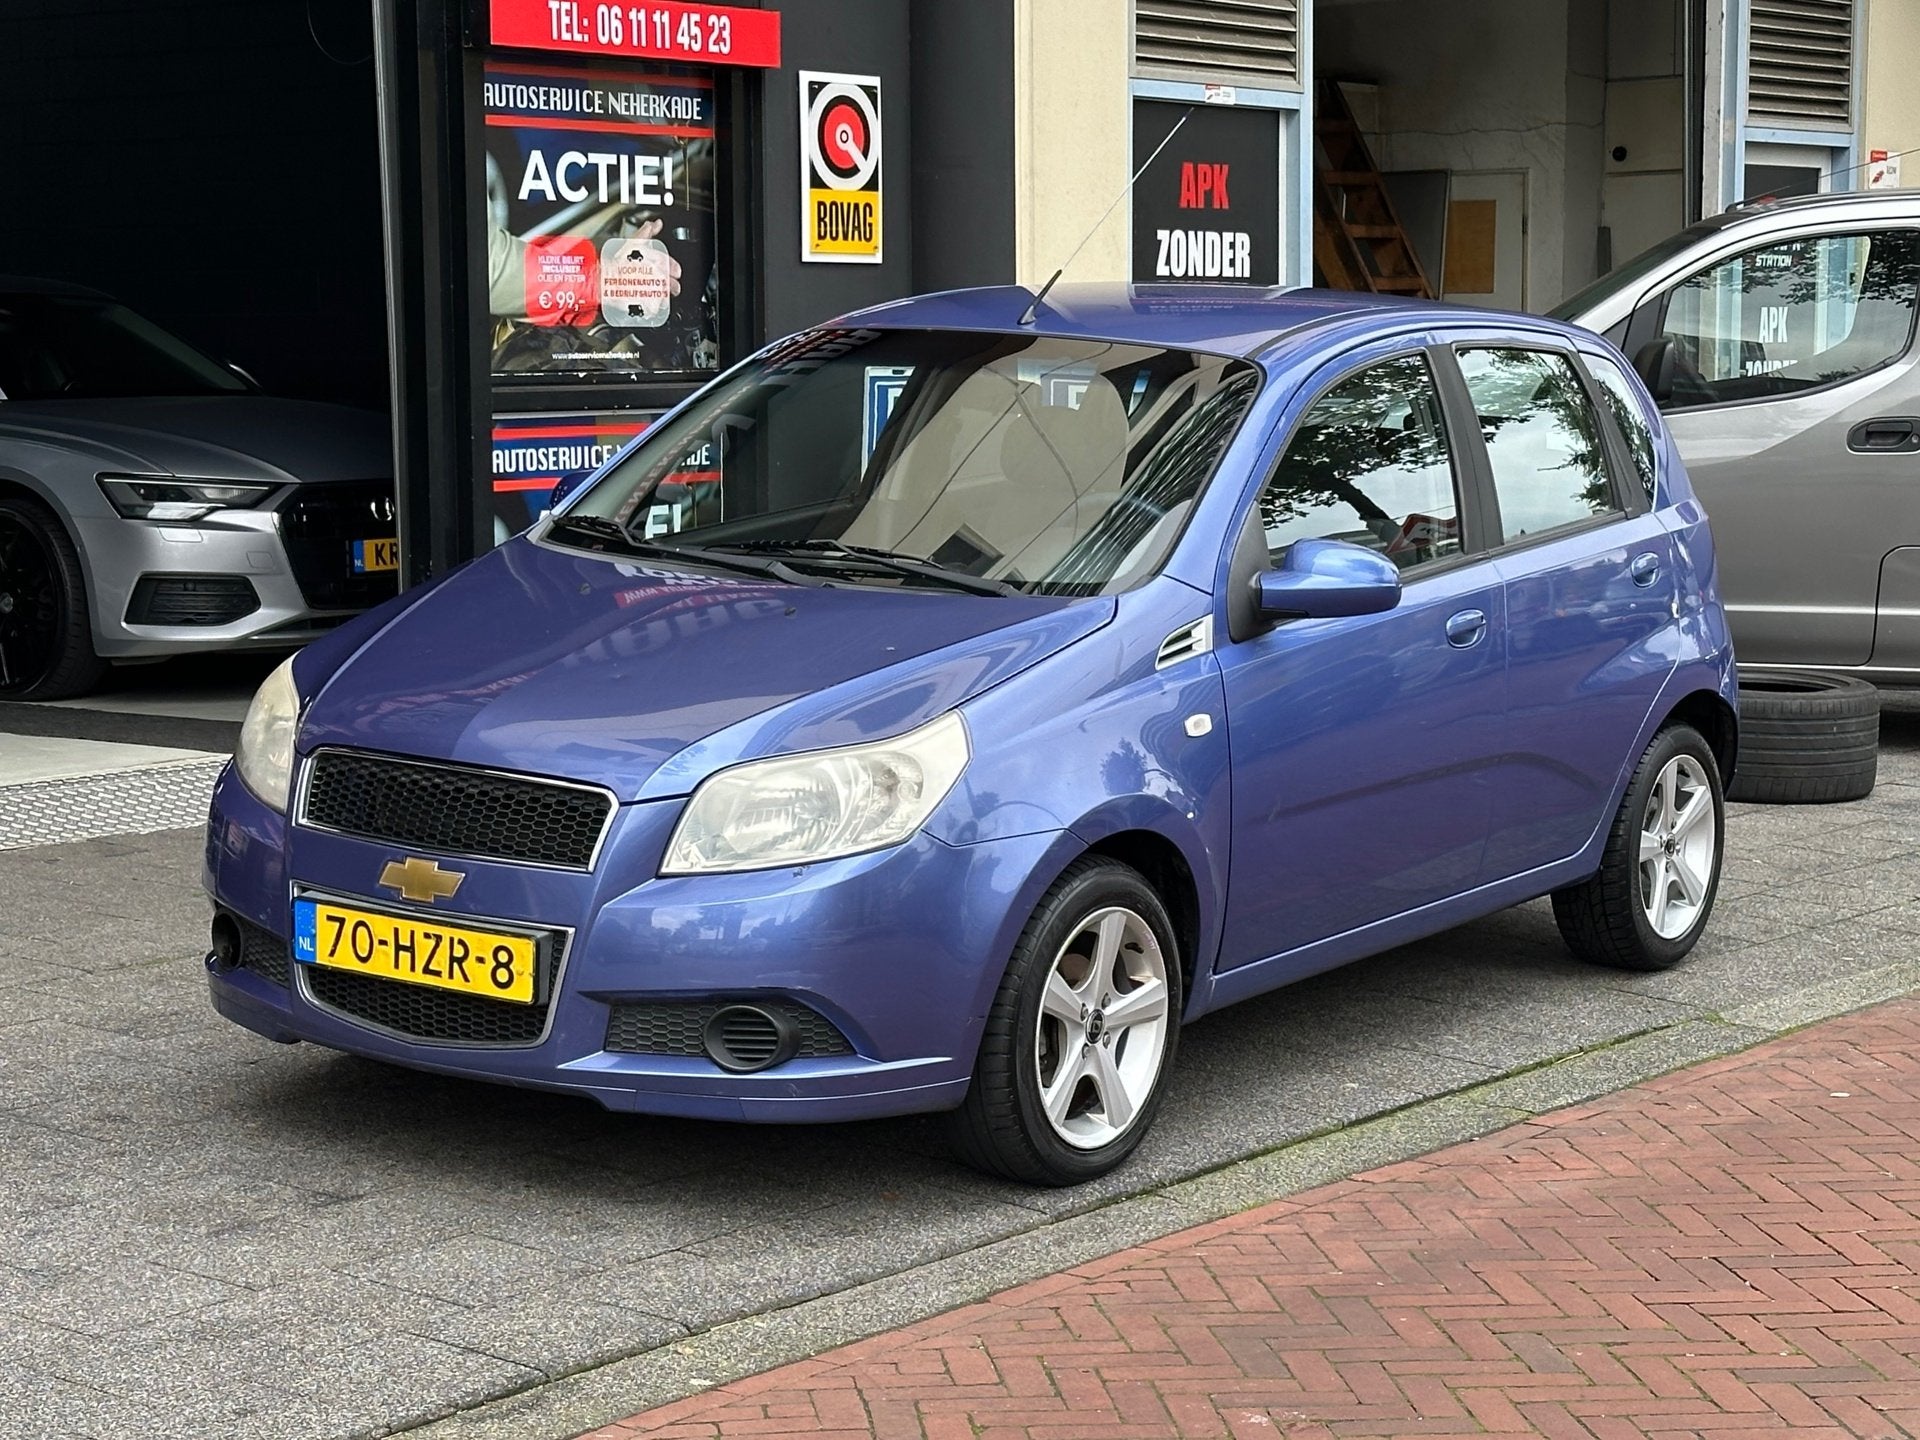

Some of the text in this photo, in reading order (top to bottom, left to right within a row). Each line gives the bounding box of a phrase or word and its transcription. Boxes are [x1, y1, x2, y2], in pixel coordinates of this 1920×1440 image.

[548, 1, 732, 54] TEL: 06 11 11 45 23
[484, 82, 702, 120] AUTOSERVICE NEHERKADE
[518, 149, 675, 206] ACTIE!
[1179, 161, 1230, 210] APK
[816, 200, 873, 243] BOVAG
[1156, 229, 1251, 278] ZONDER
[1755, 255, 1792, 267] STATION
[538, 291, 553, 309] €
[1759, 306, 1789, 343] APK
[298, 935, 316, 953] NL
[325, 914, 516, 990] 70-HZR-8
